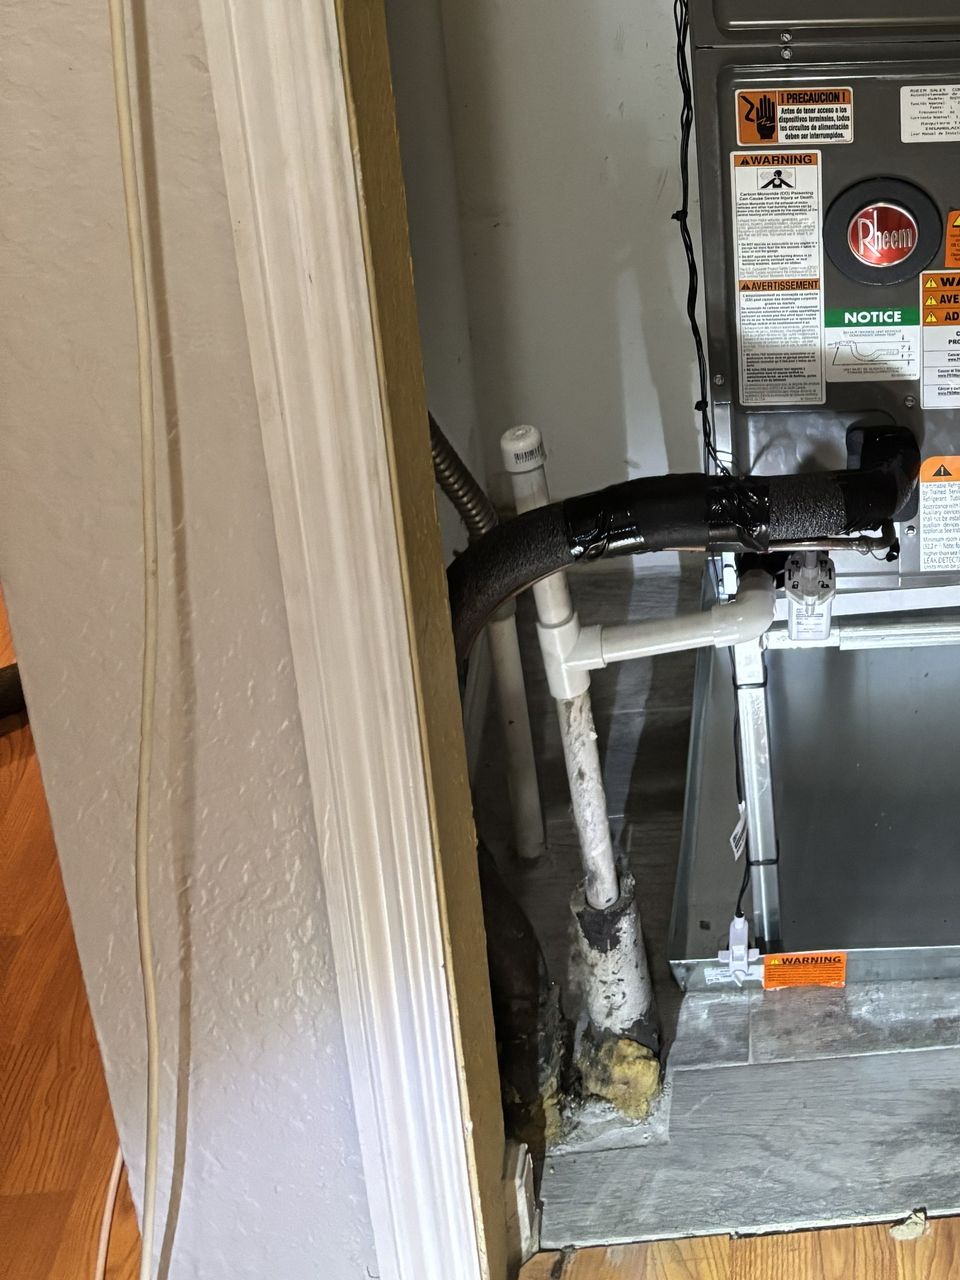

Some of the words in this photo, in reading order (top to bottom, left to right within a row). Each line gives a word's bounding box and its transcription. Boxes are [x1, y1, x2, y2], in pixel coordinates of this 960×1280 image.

[787, 92, 840, 103] PRECAUCION
[750, 155, 812, 165] WARNING
[858, 210, 912, 256] Rheem
[751, 281, 818, 290] AVERTISSEMENT
[844, 311, 902, 323] NOTICE
[782, 956, 841, 965] WARNING
